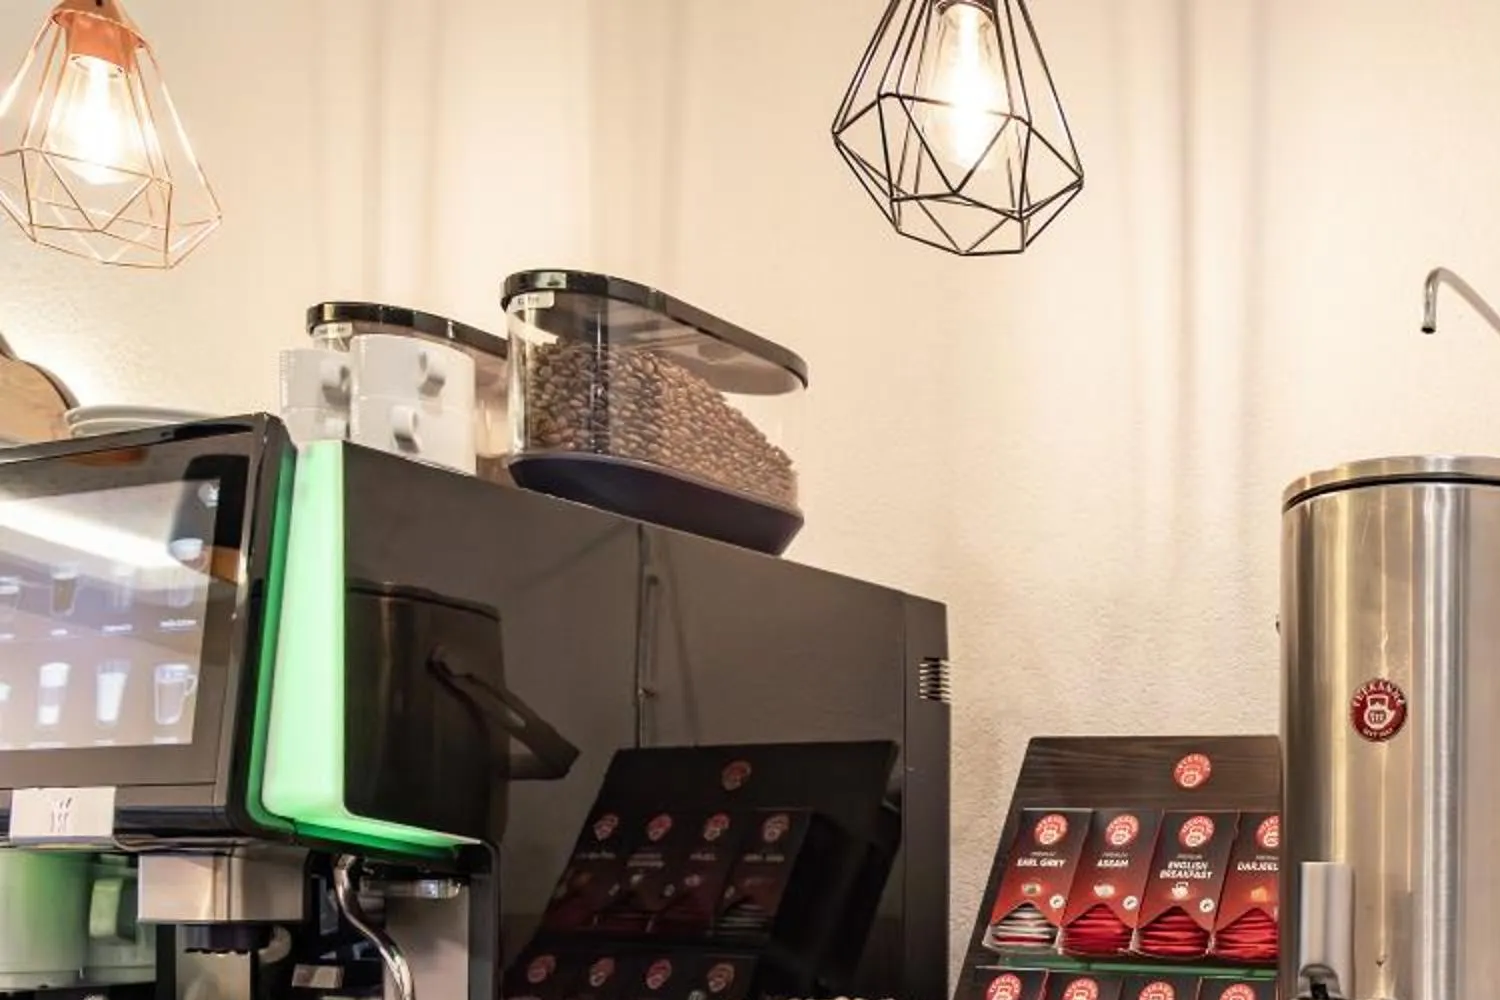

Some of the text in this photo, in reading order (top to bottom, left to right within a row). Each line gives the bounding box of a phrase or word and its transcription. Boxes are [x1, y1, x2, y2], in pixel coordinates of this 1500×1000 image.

[1040, 858, 1066, 868] GREY
[1097, 859, 1129, 867] ASSAM
[1167, 861, 1209, 870] ENGLISH
[1237, 862, 1279, 871] DARJEEL
[1159, 869, 1213, 879] BREAKFAST
